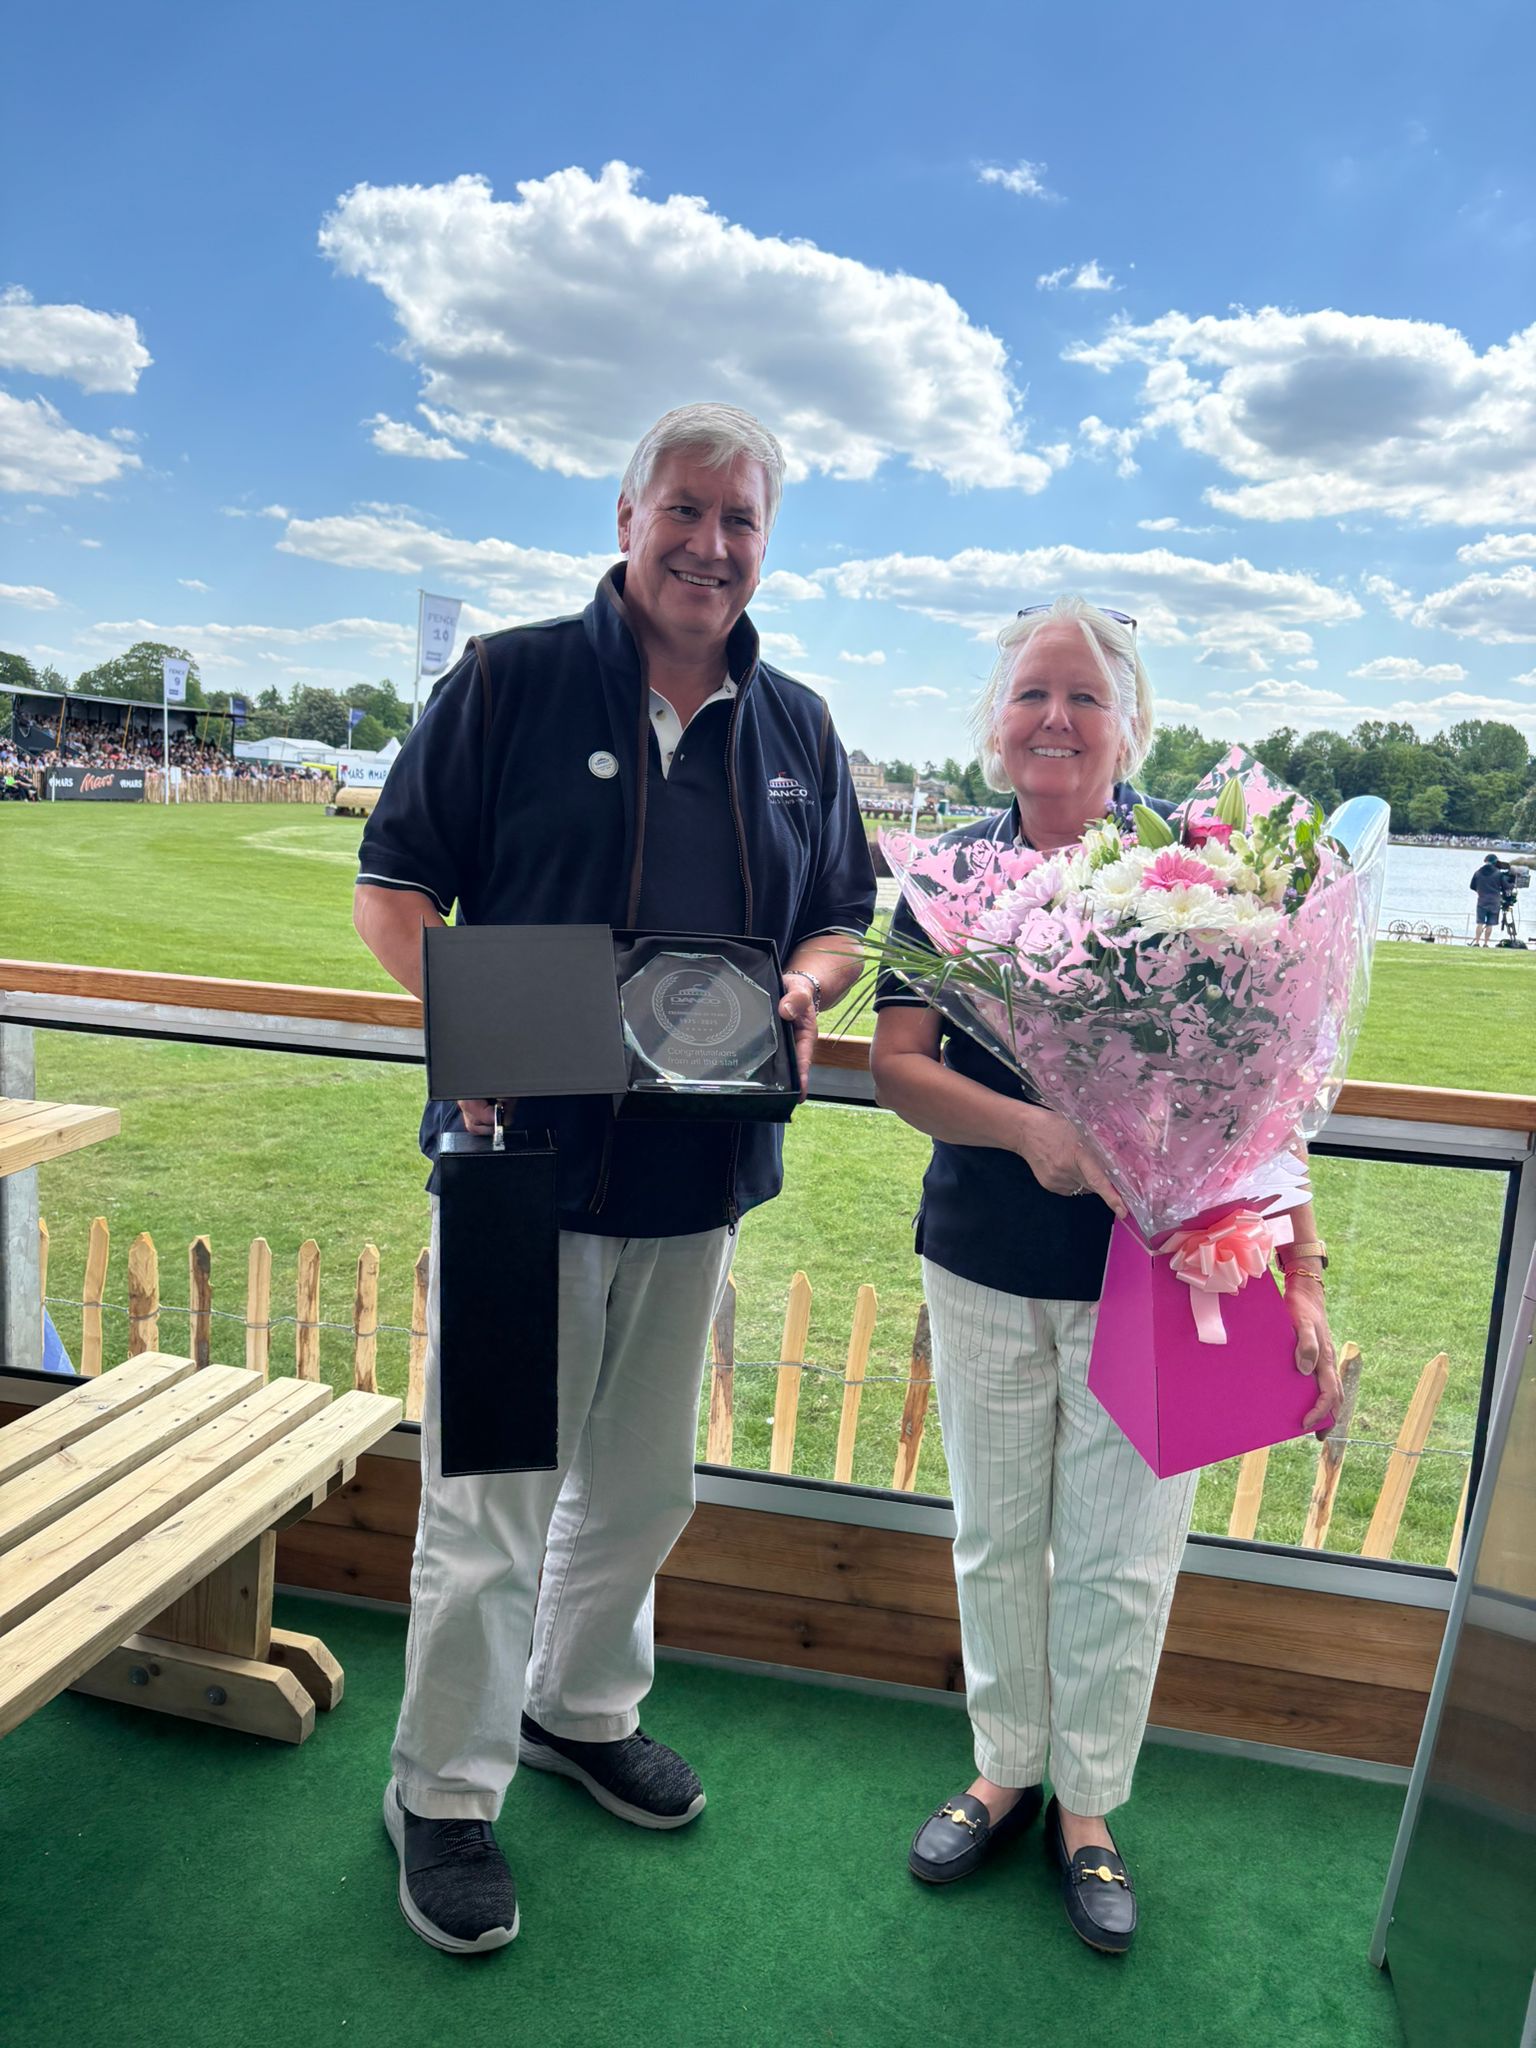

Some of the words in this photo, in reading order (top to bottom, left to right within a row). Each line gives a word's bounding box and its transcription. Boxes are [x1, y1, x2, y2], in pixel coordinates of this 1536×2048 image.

[428, 613, 456, 626] FENCE
[434, 629, 449, 642] 10
[55, 778, 73, 787] MARS
[80, 773, 114, 793] Mars
[125, 779, 143, 788] MARS
[667, 1047, 736, 1057] Congratulations
[668, 1056, 688, 1064] from
